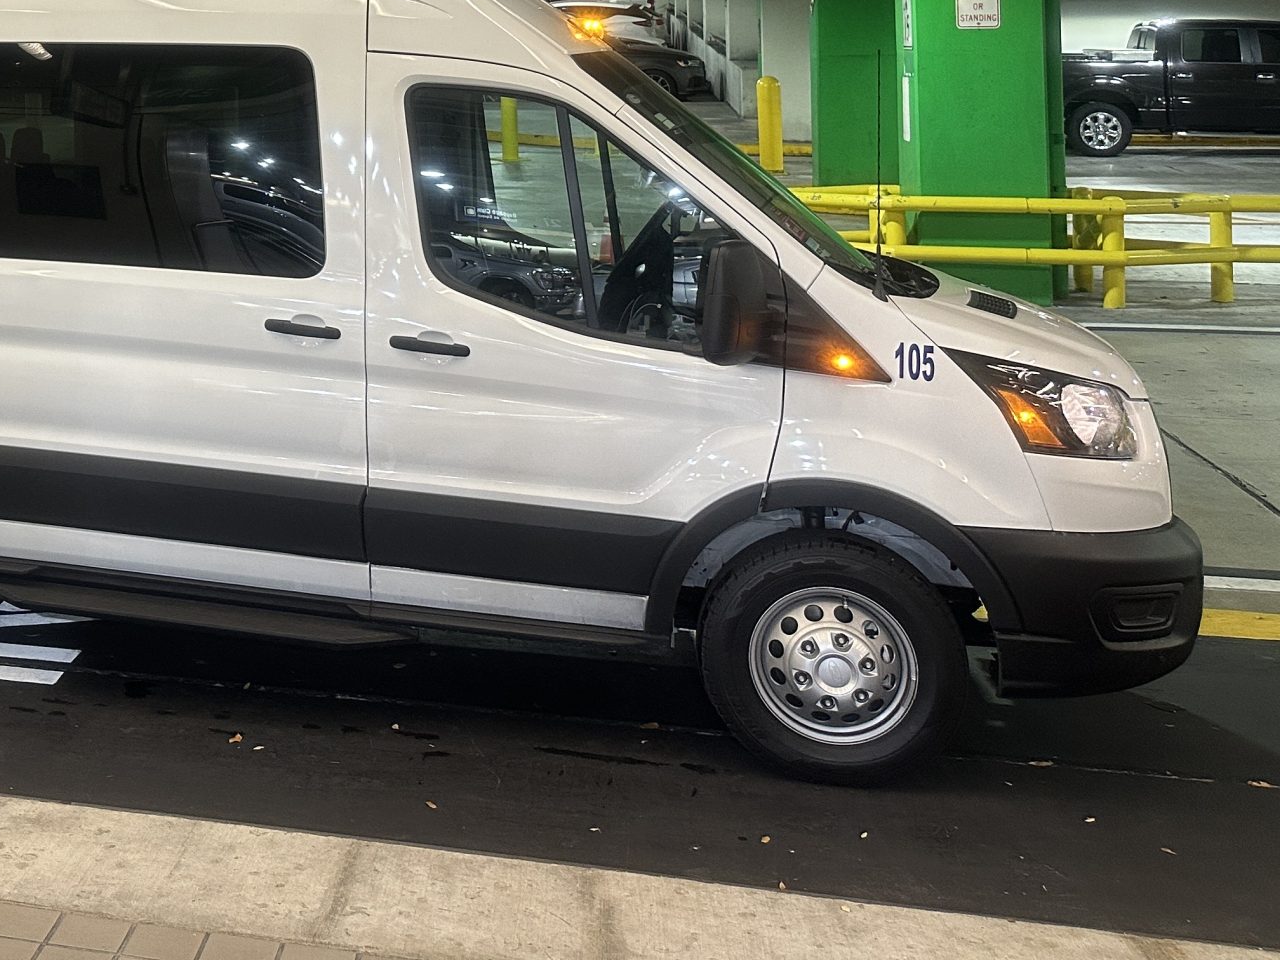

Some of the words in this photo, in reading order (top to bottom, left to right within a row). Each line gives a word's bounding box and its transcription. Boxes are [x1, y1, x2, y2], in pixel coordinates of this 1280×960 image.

[972, 2, 984, 10] OR
[960, 14, 997, 22] STANDING
[895, 341, 935, 382] 105
